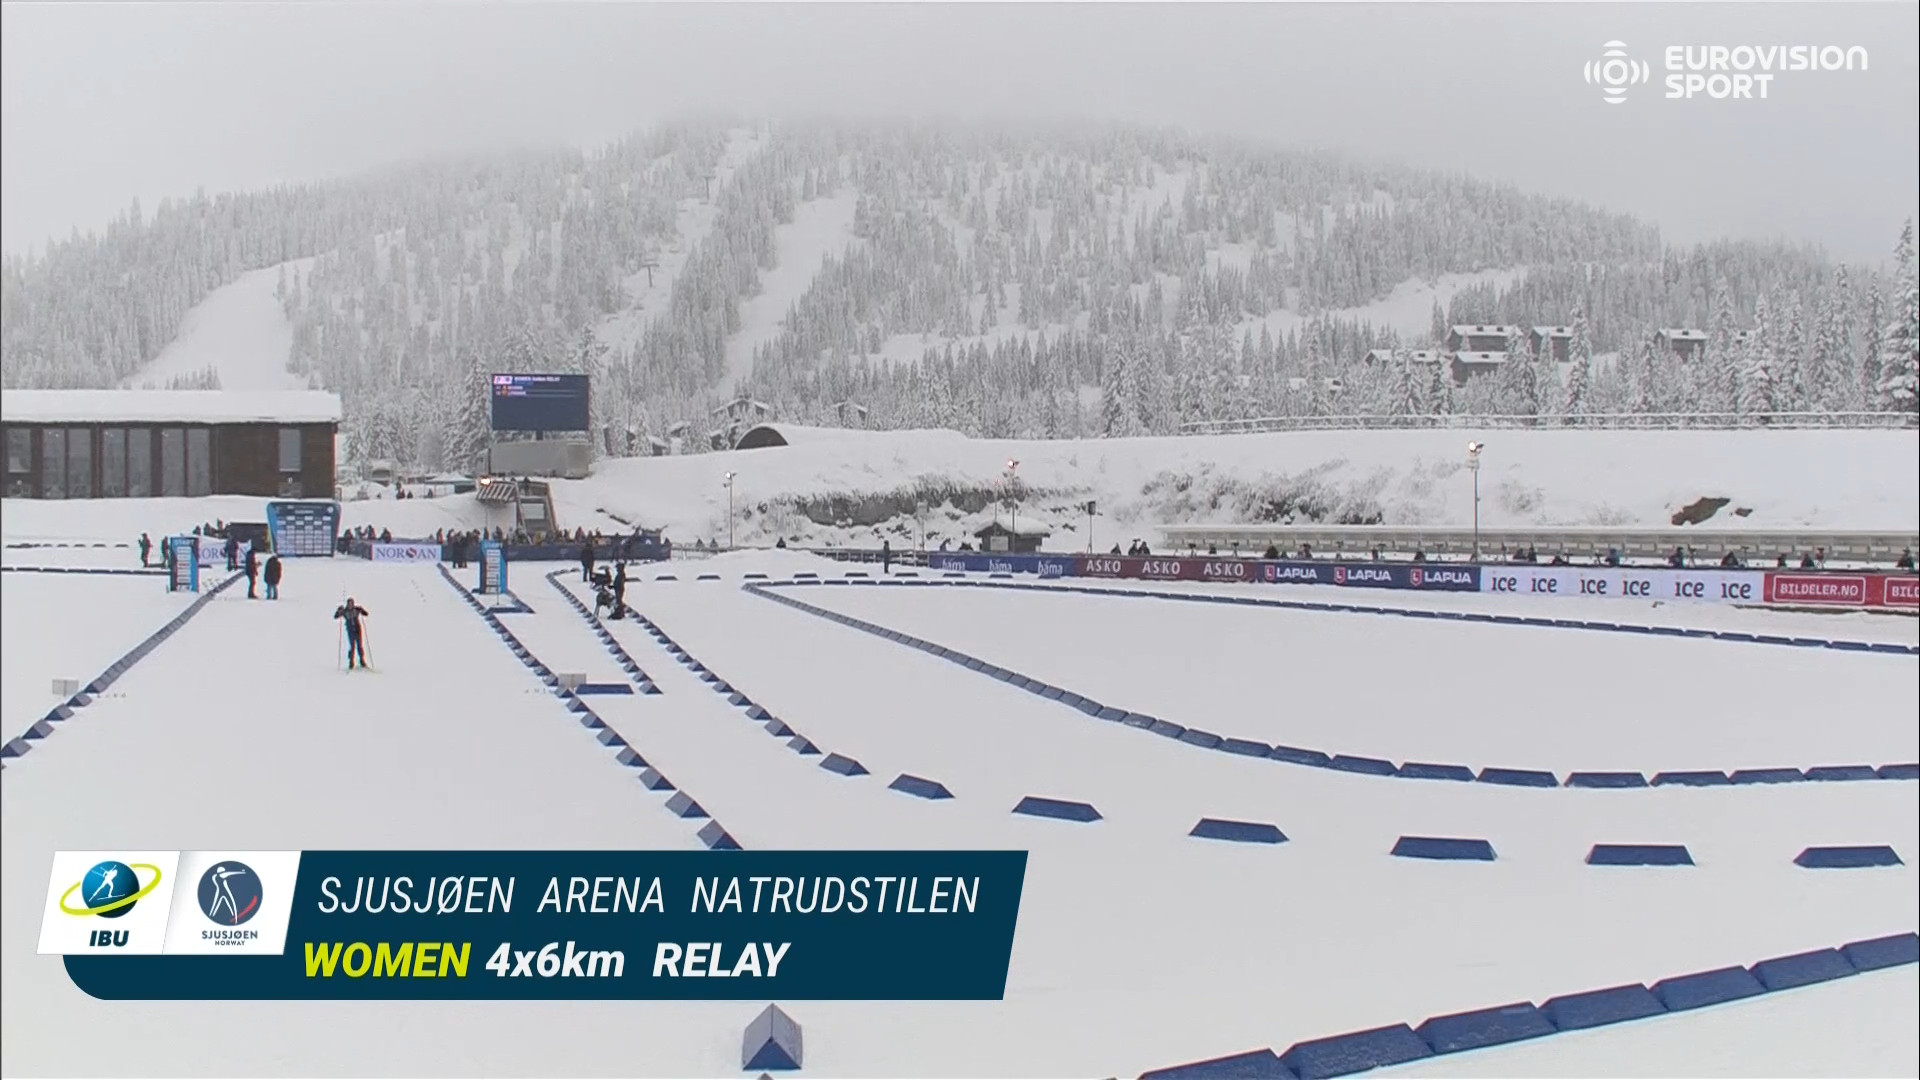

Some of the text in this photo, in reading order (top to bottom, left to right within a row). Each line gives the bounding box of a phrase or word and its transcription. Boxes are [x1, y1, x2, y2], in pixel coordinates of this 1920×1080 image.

[1086, 560, 1122, 573] ASKO
[1142, 561, 1181, 575] ASKO
[1203, 562, 1244, 577] ASKO
[1276, 568, 1317, 579] LAPUA
[1348, 569, 1391, 581] LAPUA
[1424, 571, 1471, 583] LAPUA
[1491, 571, 1557, 592] ice ice
[1580, 573, 1651, 596] ice ice
[1674, 574, 1752, 599] ice ice
[1780, 583, 1859, 596] BILDELER.NO
